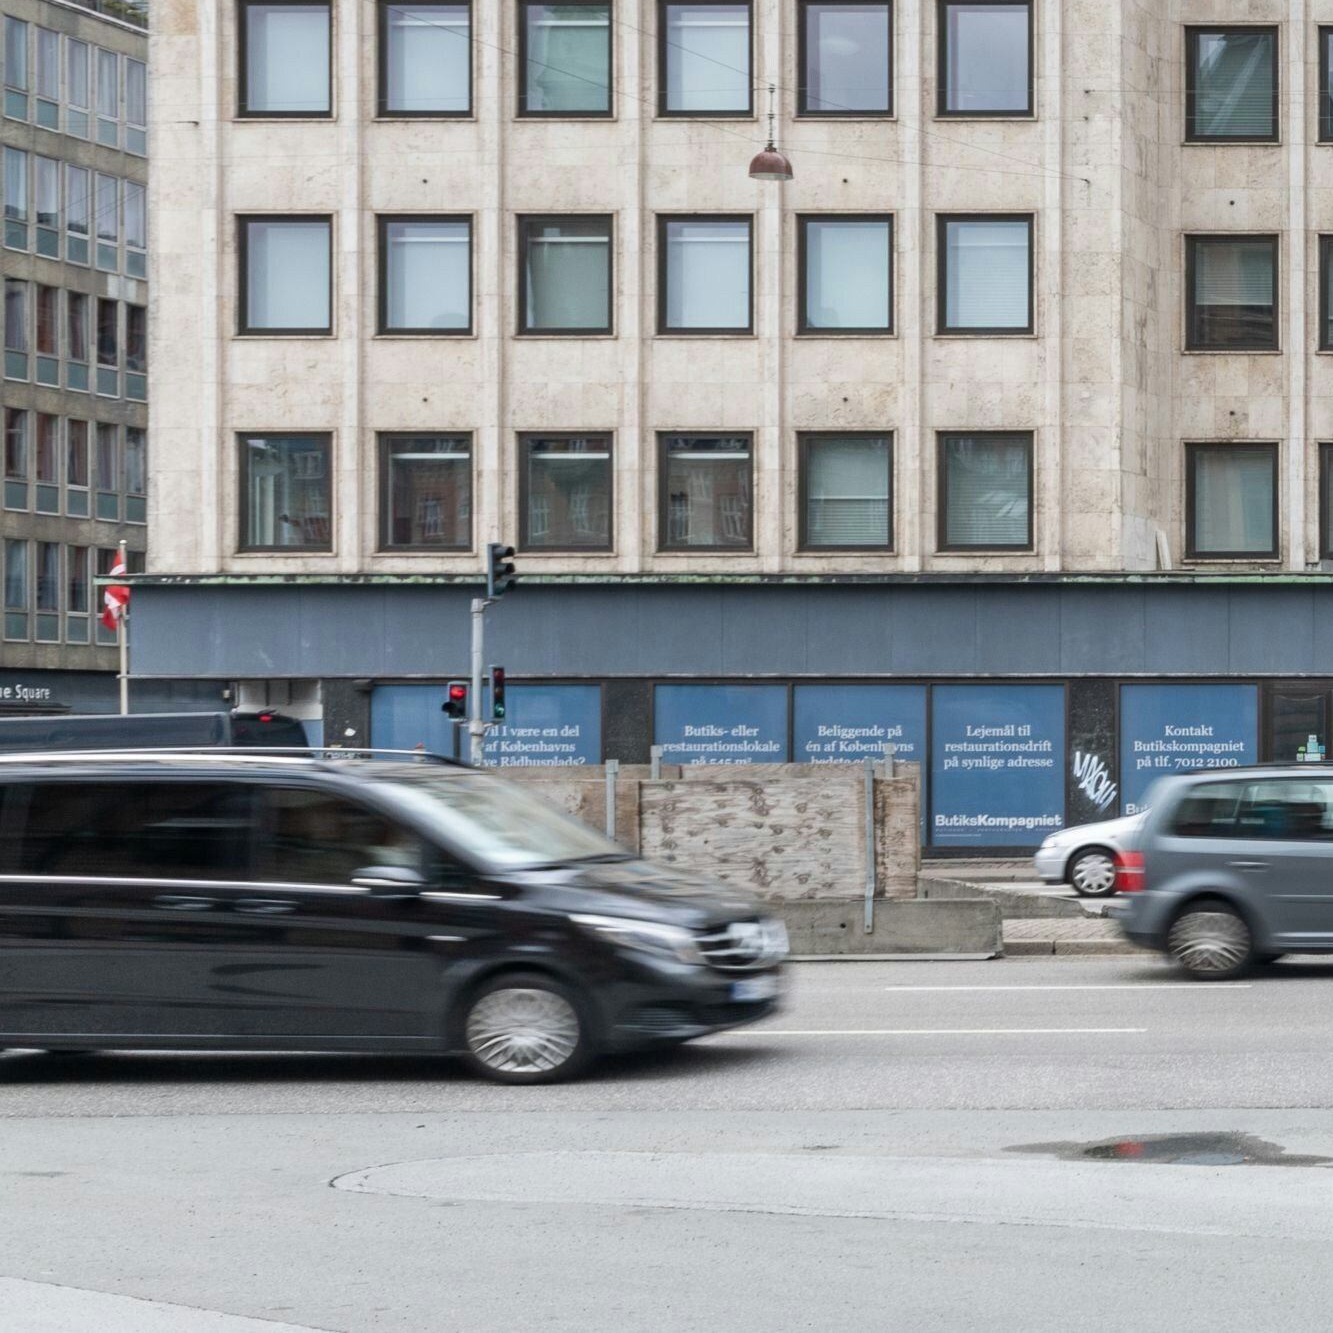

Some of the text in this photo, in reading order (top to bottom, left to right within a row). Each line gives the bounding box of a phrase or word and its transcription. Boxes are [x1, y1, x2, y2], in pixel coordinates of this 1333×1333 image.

[15, 684, 50, 702] Square
[510, 728, 540, 737] være
[542, 728, 558, 737] en
[560, 725, 580, 737] del
[684, 725, 760, 737] Butiks- eller
[817, 725, 903, 739] Beliggende på
[966, 725, 1031, 739] Lejemål til
[1165, 725, 1213, 737] Kontakt
[485, 740, 576, 752] af Københavns
[662, 740, 781, 752] restaurationslokale
[805, 740, 914, 752] én af Københvns
[944, 740, 1053, 752] restaurationsdrift
[1134, 740, 1245, 754] Butikskompagniet
[943, 755, 1053, 770] på synlige adresse
[1136, 755, 1151, 770] på
[1154, 755, 1171, 767] tlf.
[1174, 757, 1203, 770] 7012
[935, 814, 1062, 828] ButiksKompagniet
